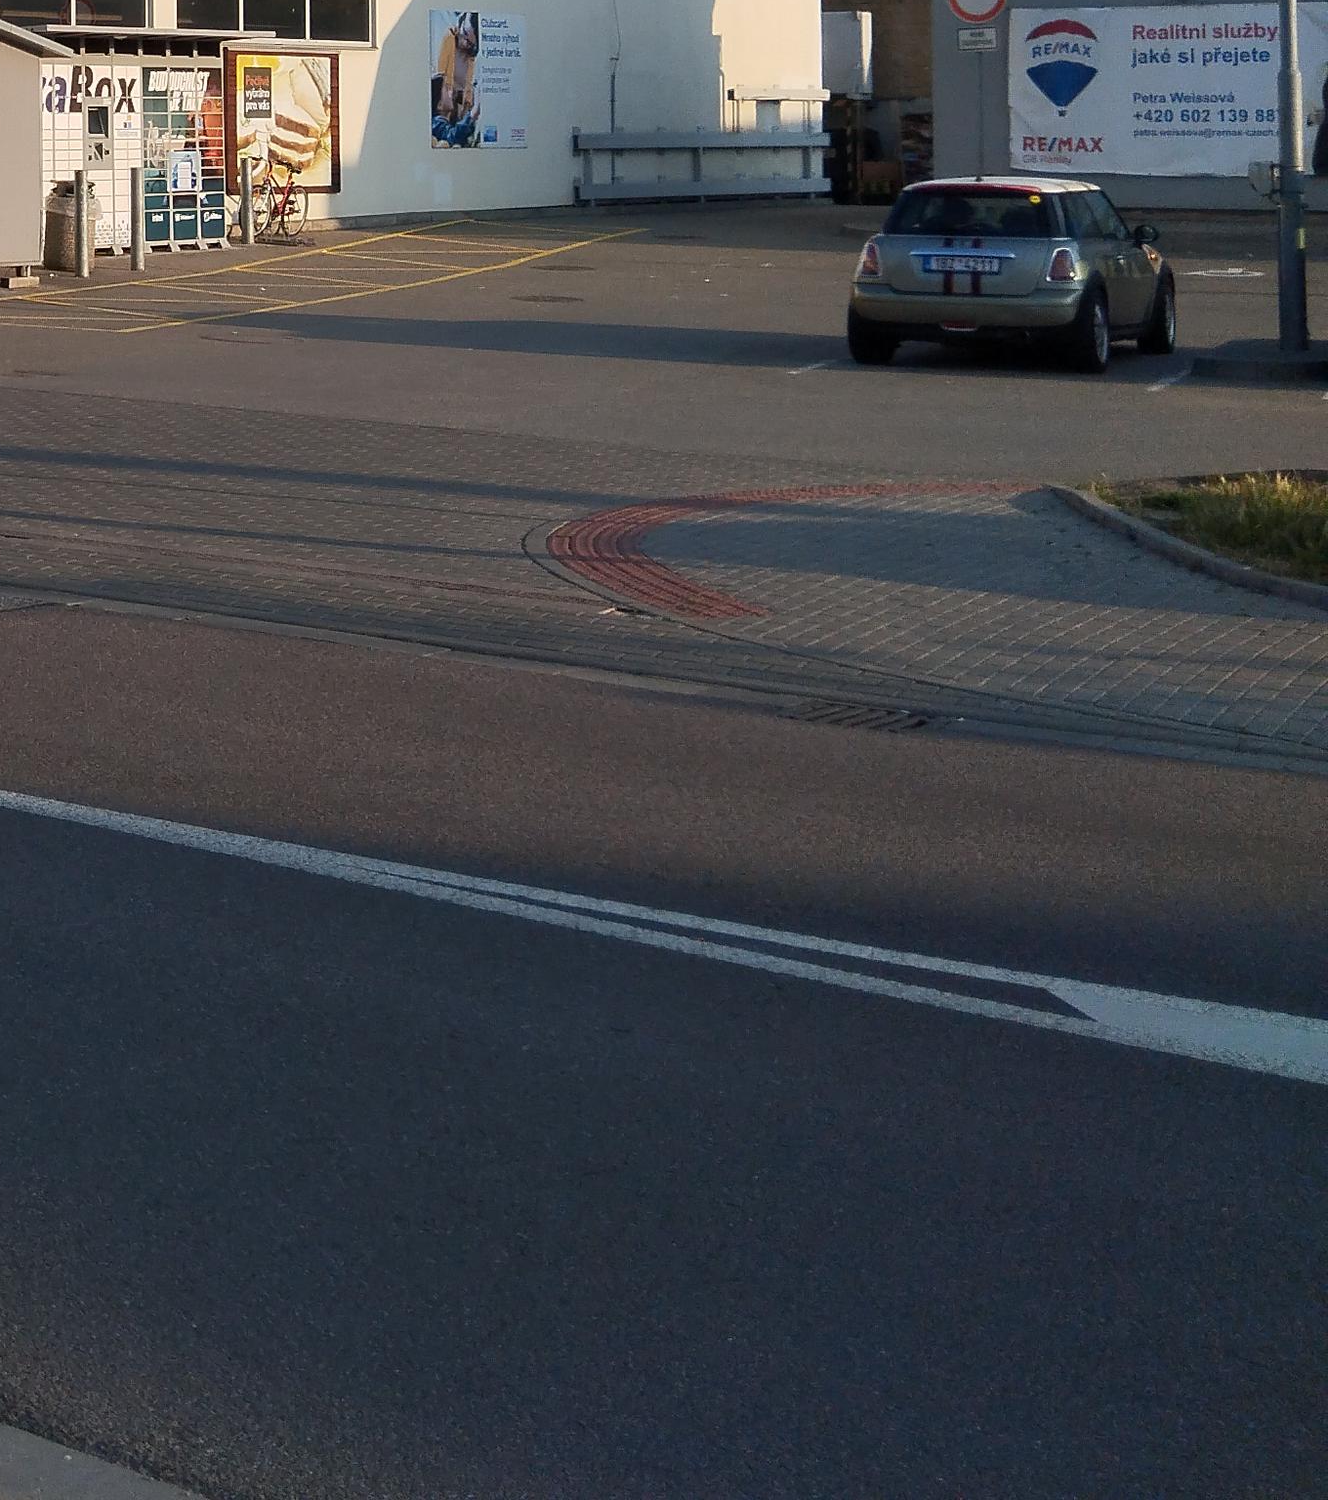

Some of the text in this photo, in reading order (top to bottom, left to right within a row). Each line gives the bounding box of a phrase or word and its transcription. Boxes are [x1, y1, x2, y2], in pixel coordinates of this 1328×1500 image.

[1212, 22, 1279, 42] služby
[1032, 42, 1093, 59] RE/MAX
[1131, 49, 1171, 68] jaké
[1202, 46, 1271, 67] přejete
[1132, 92, 1235, 104] Petra Weissová
[1133, 109, 1279, 122] +420 602 139 88
[1022, 136, 1103, 152] RE/MAX
